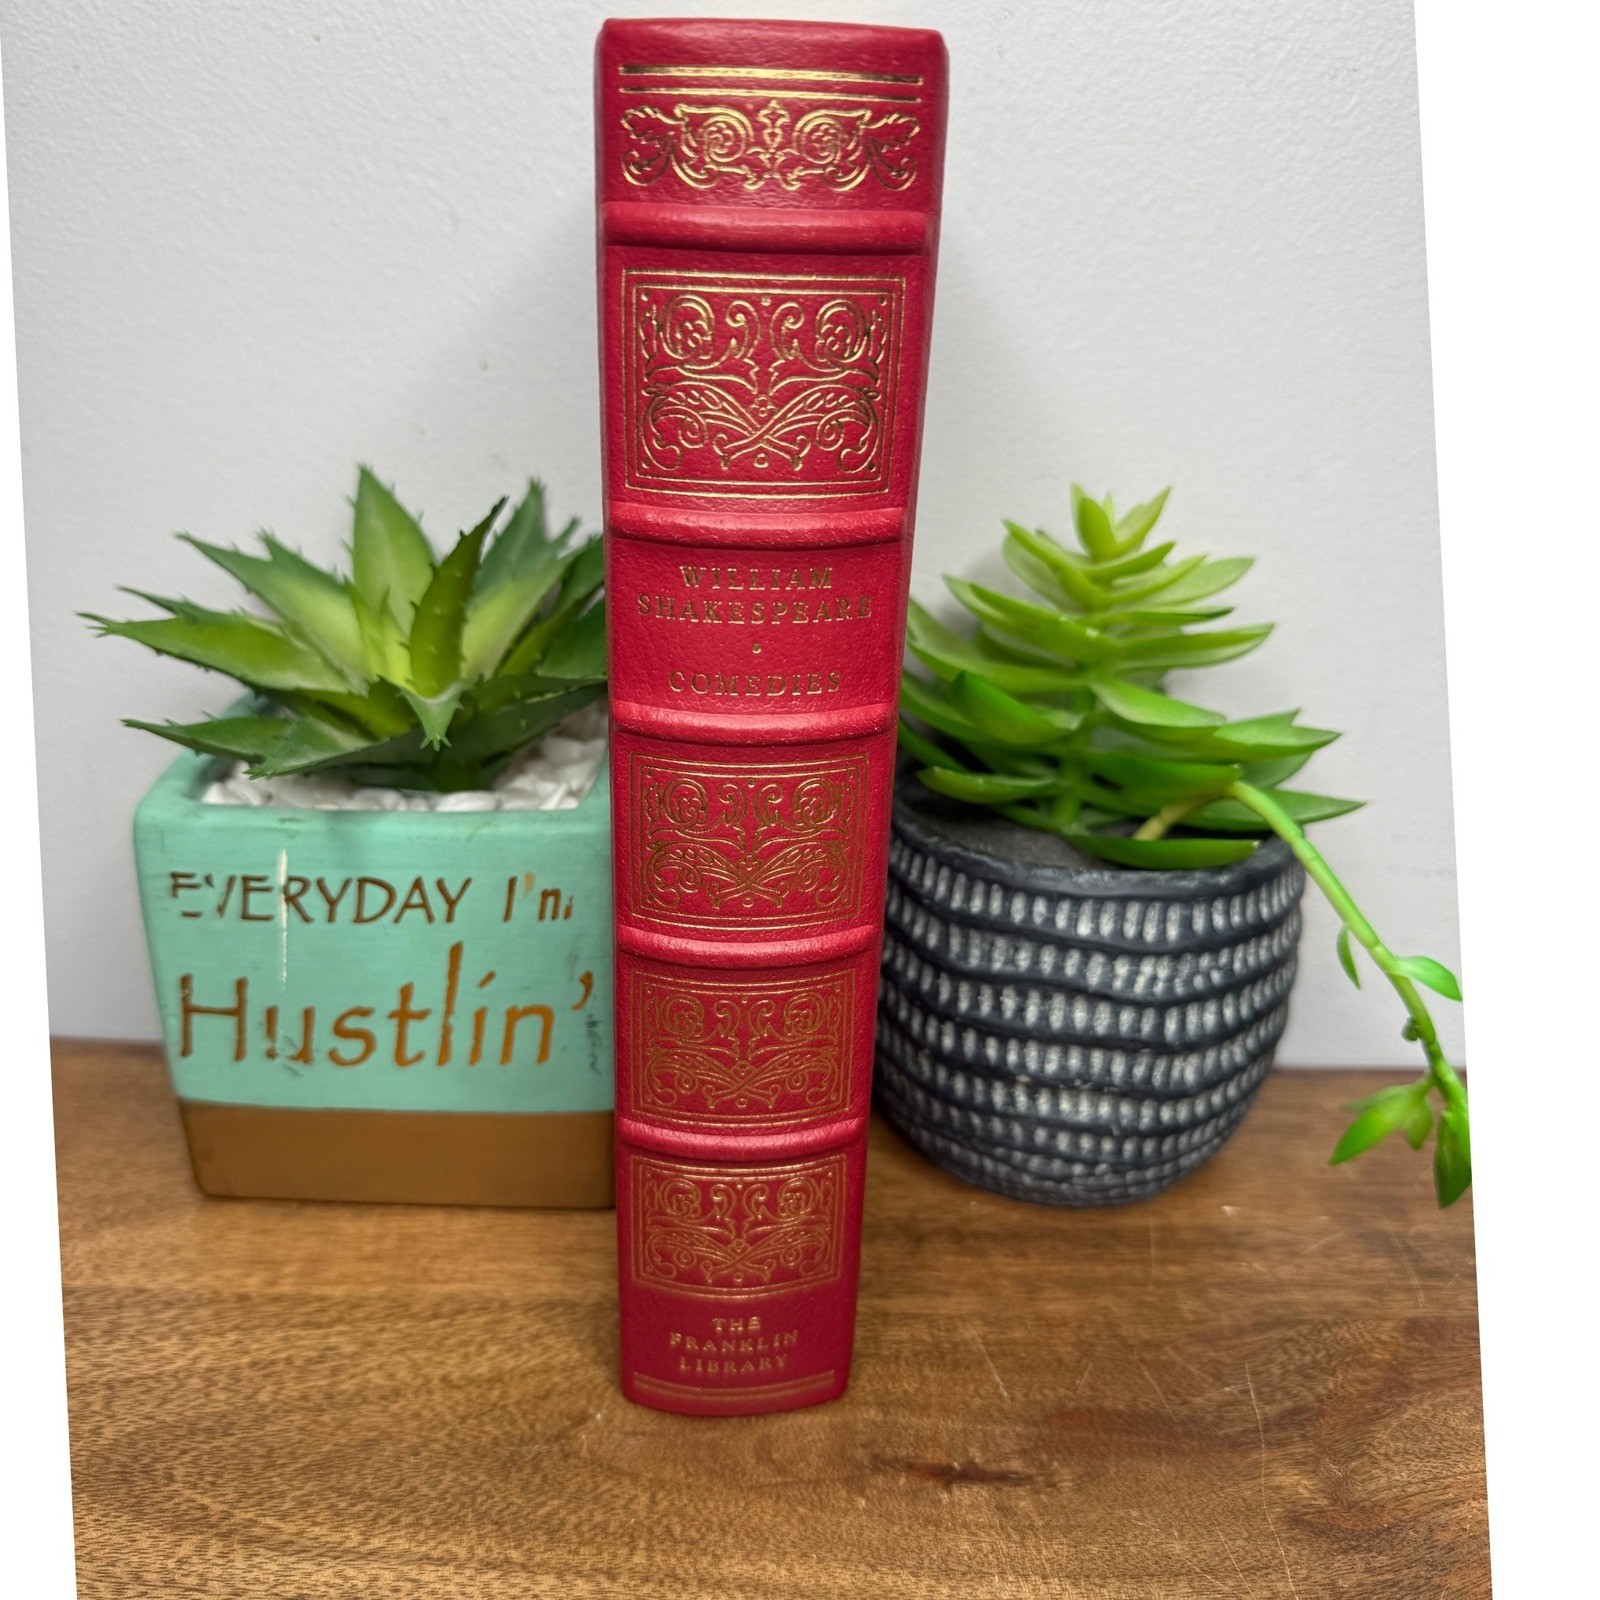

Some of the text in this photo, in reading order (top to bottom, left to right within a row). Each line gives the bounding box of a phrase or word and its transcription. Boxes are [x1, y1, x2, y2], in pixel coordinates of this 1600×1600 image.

[679, 565, 833, 591] WILLIAM
[636, 594, 872, 624] SHAKESPEARE
[668, 671, 842, 697] COMEDIES
[169, 870, 473, 924] EVERYDAY
[178, 940, 595, 1067] Hustlin'
[711, 1315, 761, 1331] THE
[669, 1330, 798, 1351] FRANKLIN
[679, 1354, 788, 1372] LIBRARY
